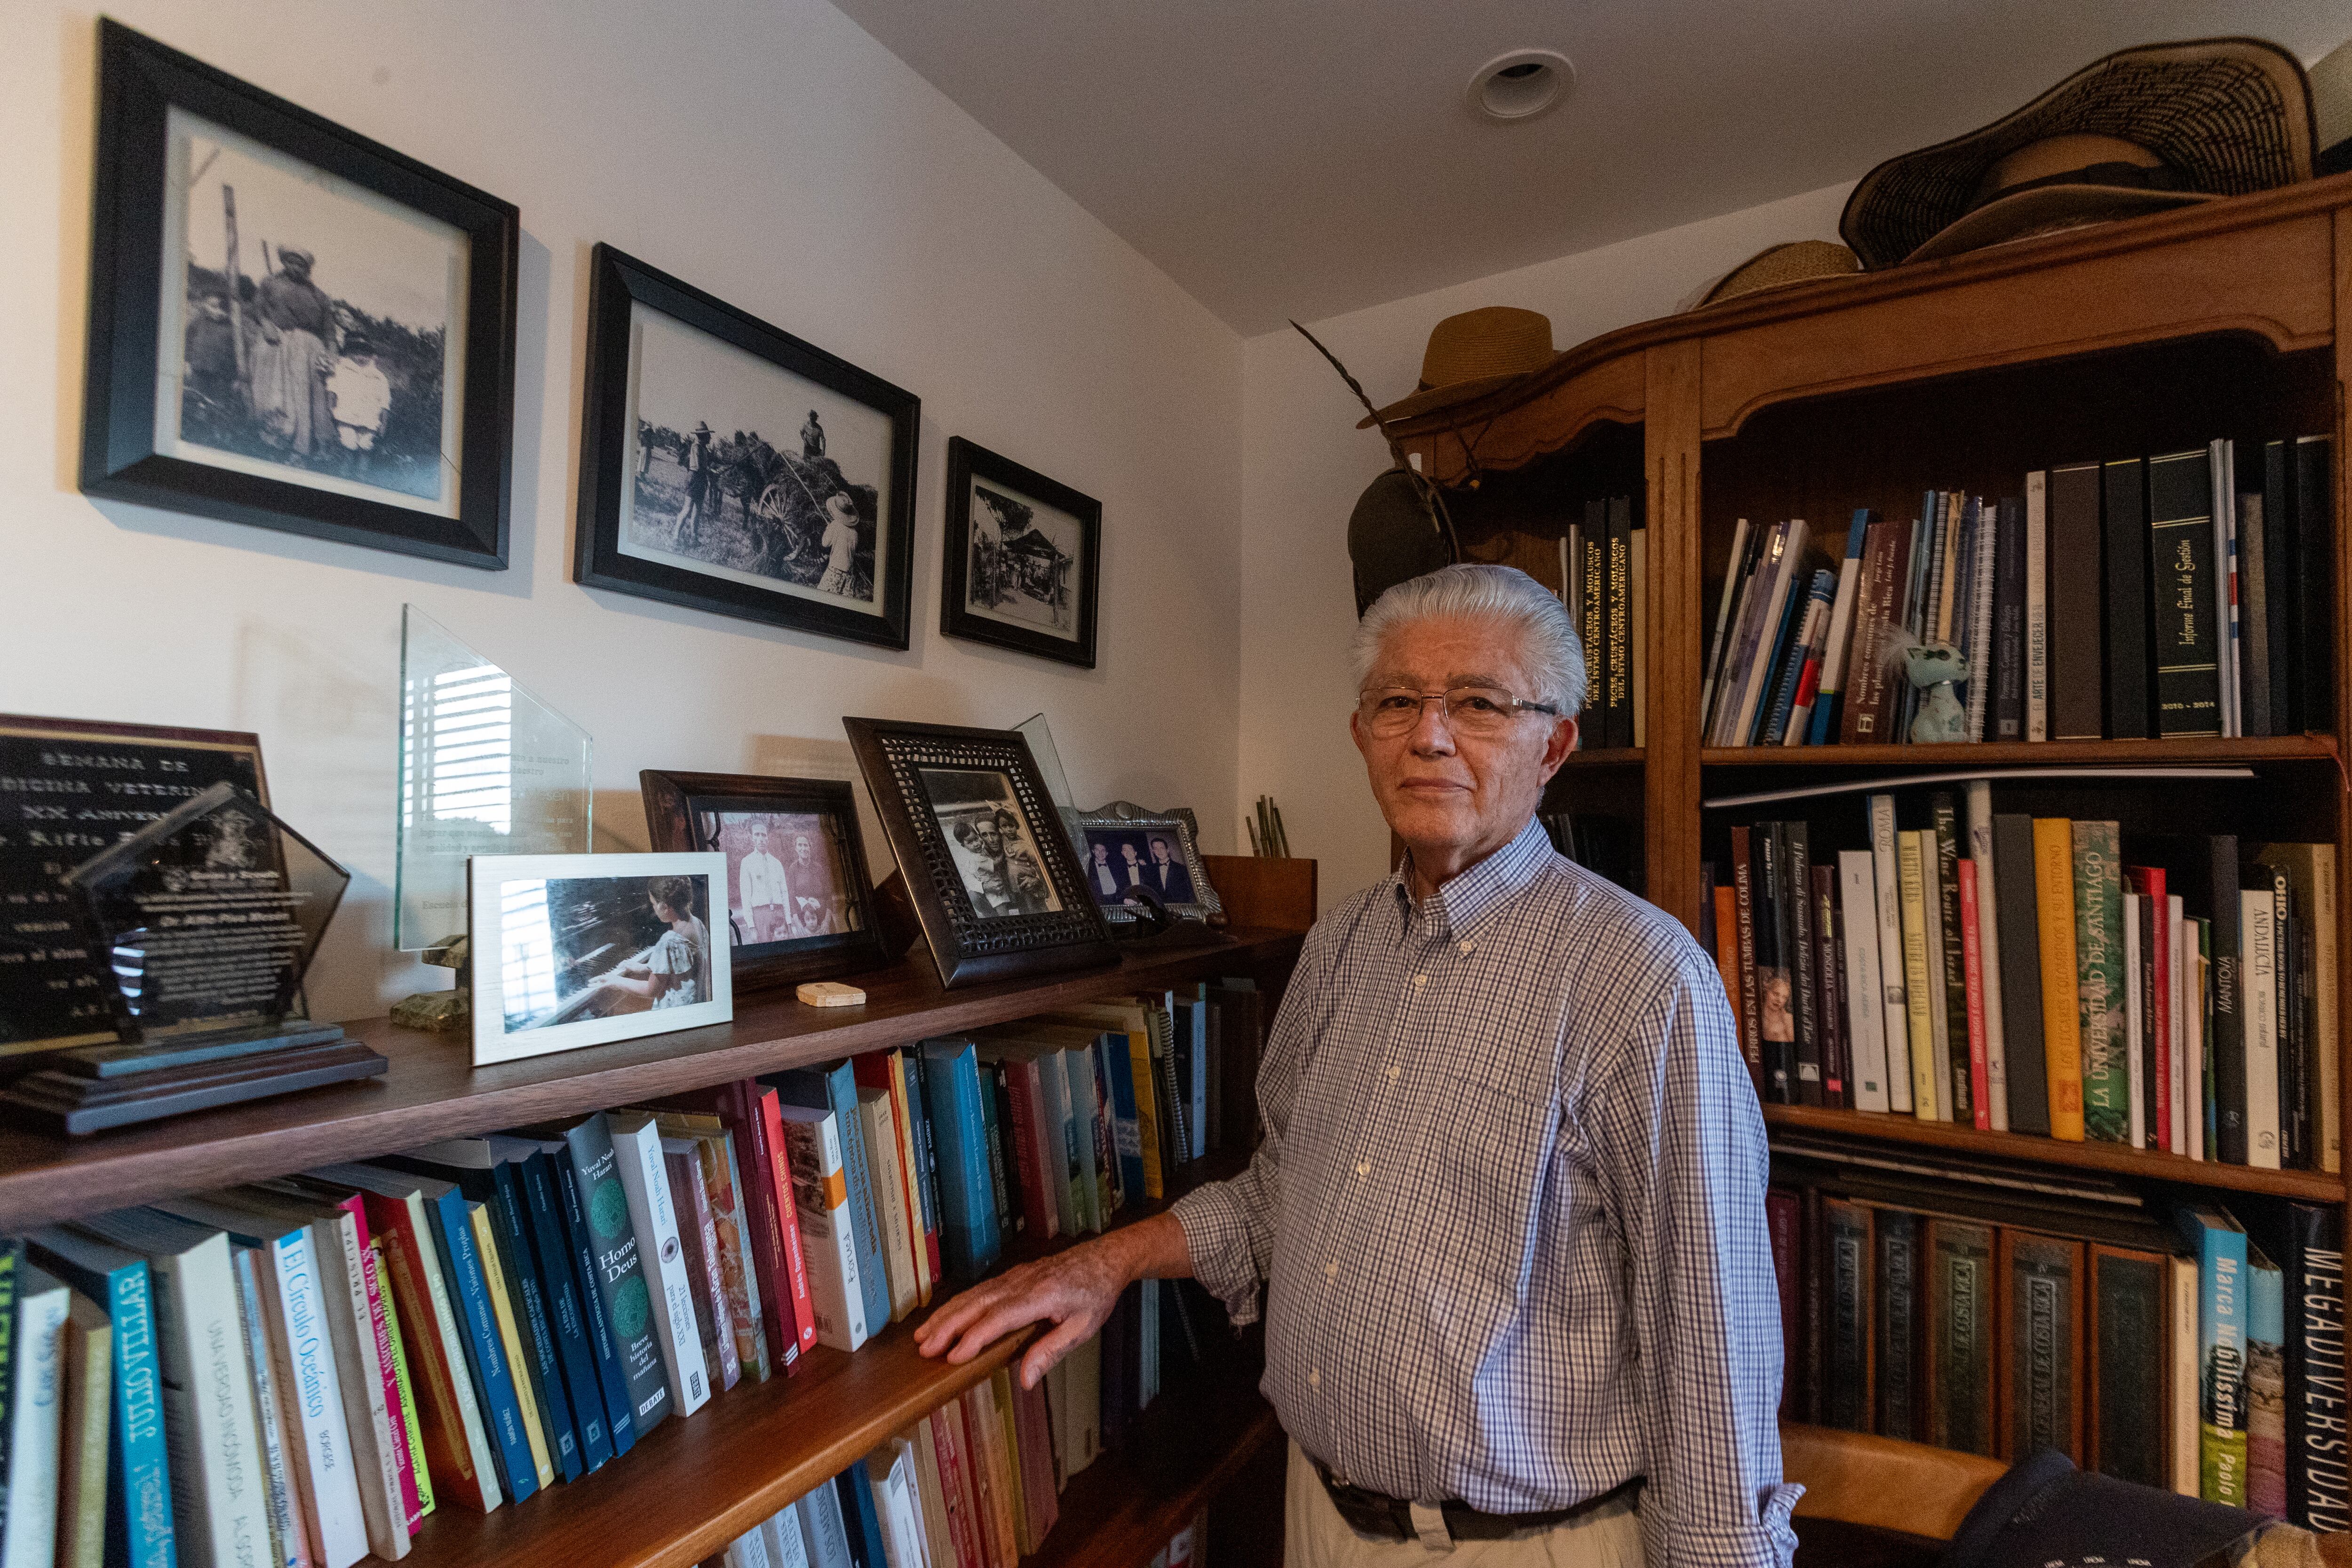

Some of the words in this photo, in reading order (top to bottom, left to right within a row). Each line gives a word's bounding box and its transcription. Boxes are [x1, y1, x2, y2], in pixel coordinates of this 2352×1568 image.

[1586, 541, 1595, 593] MOLUSCOS
[2174, 540, 2195, 571] Gestión
[2177, 574, 2192, 584] de
[1592, 548, 1602, 645] CENTROAMERICANO
[1616, 546, 1629, 643] CENTROAMERICANO
[2177, 587, 2193, 610] Final
[1584, 611, 1594, 674] CRUSTÁCEOS
[1610, 611, 1619, 673] CRUSTÁCEOS
[2032, 622, 2043, 666] ENVEJECER
[2178, 613, 2198, 645] Informe
[1856, 661, 1870, 705] Nombres
[1867, 603, 1877, 616] de
[1869, 690, 1880, 705] las
[1882, 585, 1892, 607] Rica
[1610, 676, 1619, 708] PECES,
[2032, 680, 2043, 699] ARTE
[42, 753, 146, 770] SEMANA
[159, 759, 189, 772] DE
[1876, 809, 1895, 852] ROMA
[1937, 806, 1954, 832] The
[1793, 850, 1804, 885] Palazzo
[1938, 839, 1956, 878] Wine
[1736, 864, 1749, 906] COLIMA
[1796, 886, 1804, 896] di
[2083, 852, 2105, 937] SANTIAGO
[1739, 909, 1750, 923] DE
[1941, 883, 1958, 923] Route
[1740, 927, 1753, 972] TUMBAS
[1943, 928, 1958, 941] of
[2252, 907, 2273, 976] ANDALUCÍA
[1798, 940, 1808, 970] Delizia
[1824, 944, 1833, 988] MONGOLIA
[1945, 949, 1961, 987] Israel
[2087, 943, 2105, 964] DE
[1743, 977, 1755, 998] LAS
[1800, 972, 1810, 985] dei
[2215, 955, 2235, 1014] MANTOVA
[1745, 1000, 1756, 1015] EN
[1801, 987, 1812, 1014] Duchi
[2088, 969, 2110, 1080] UNIVERSIDAD
[1746, 1019, 1759, 1063] PERROS
[2094, 1087, 2110, 1105] LA
[581, 1158, 601, 1177] Yuval
[599, 1148, 614, 1167] Noah
[593, 1162, 612, 1181] Harari
[645, 1144, 660, 1171] Yuval
[774, 1151, 788, 1182] CHINOS
[650, 1170, 665, 1195] Noah
[851, 1175, 860, 1191] de
[884, 1159, 897, 1202] DISCURSOS
[655, 1195, 671, 1226] Harari
[779, 1182, 795, 1219] CUENTOS
[360, 1244, 373, 1264] XX
[454, 1225, 473, 1260] Propias
[581, 1247, 591, 1266] RICA
[599, 1236, 636, 1270] Homo
[703, 1222, 717, 1271] Talamanca
[787, 1223, 803, 1273] Oppenheimer
[282, 1248, 305, 1272] El
[607, 1254, 637, 1283] Deus
[364, 1263, 380, 1297] SIGLO
[585, 1265, 596, 1288] COSTA
[676, 1286, 687, 1297] 21
[708, 1267, 720, 1292] Gran
[794, 1272, 806, 1299] Andrés
[1954, 1264, 1970, 1292] RICA
[2215, 1256, 2237, 1315] Marca
[286, 1272, 316, 1338] Círculo
[377, 1284, 391, 1317] EXPRESS
[520, 1277, 537, 1317] CACICALES
[557, 1297, 566, 1309] DE
[562, 1281, 578, 1328] ENCOMIENDA
[590, 1287, 598, 1298] DE
[665, 1284, 678, 1302] para
[671, 1301, 680, 1310] el
[2034, 1282, 2050, 1313] RICA
[117, 1270, 150, 1370] VILLAR
[370, 1296, 384, 1321] DEL
[474, 1299, 492, 1339] Comunes
[535, 1311, 545, 1329] RICA
[560, 1308, 569, 1324] ERA
[592, 1298, 604, 1328] ANTIGUA
[670, 1309, 684, 1330] siglo
[675, 1295, 696, 1331] lecciones
[1954, 1294, 1970, 1331] COSTA
[383, 1317, 396, 1345] ORIENT
[530, 1317, 547, 1361] SOCIEDADES
[540, 1328, 550, 1350] COSTA
[564, 1323, 572, 1334] LA
[572, 1327, 580, 1339] LA
[598, 1327, 612, 1360] HISTORIA
[630, 1334, 649, 1353] Breve
[674, 1328, 688, 1346] XXI
[374, 1320, 395, 1374] MÁRTIRES
[389, 1345, 398, 1355] EL
[391, 1355, 400, 1367] EN
[483, 1338, 501, 1377] Nombres
[545, 1350, 554, 1364] DE
[629, 1341, 653, 1364] historia
[638, 1353, 649, 1367] del
[297, 1337, 329, 1417] Oceánico
[386, 1377, 397, 1387] Y
[540, 1360, 551, 1375] LAS
[632, 1356, 658, 1381] mañana
[2214, 1322, 2238, 1440] Nobilissima
[211, 1358, 235, 1418] VERDAD
[394, 1368, 408, 1408] ASESINATO
[687, 1372, 704, 1399] DEBATE
[2302, 1245, 2350, 1533] MEGADIVERSIDAD
[125, 1367, 156, 1443] JULIO
[640, 1388, 665, 1415] DEBATE
[409, 1444, 421, 1474] AGATHA
[2217, 1452, 2236, 1494] Paolo
[823, 1535, 838, 1563] LOS
